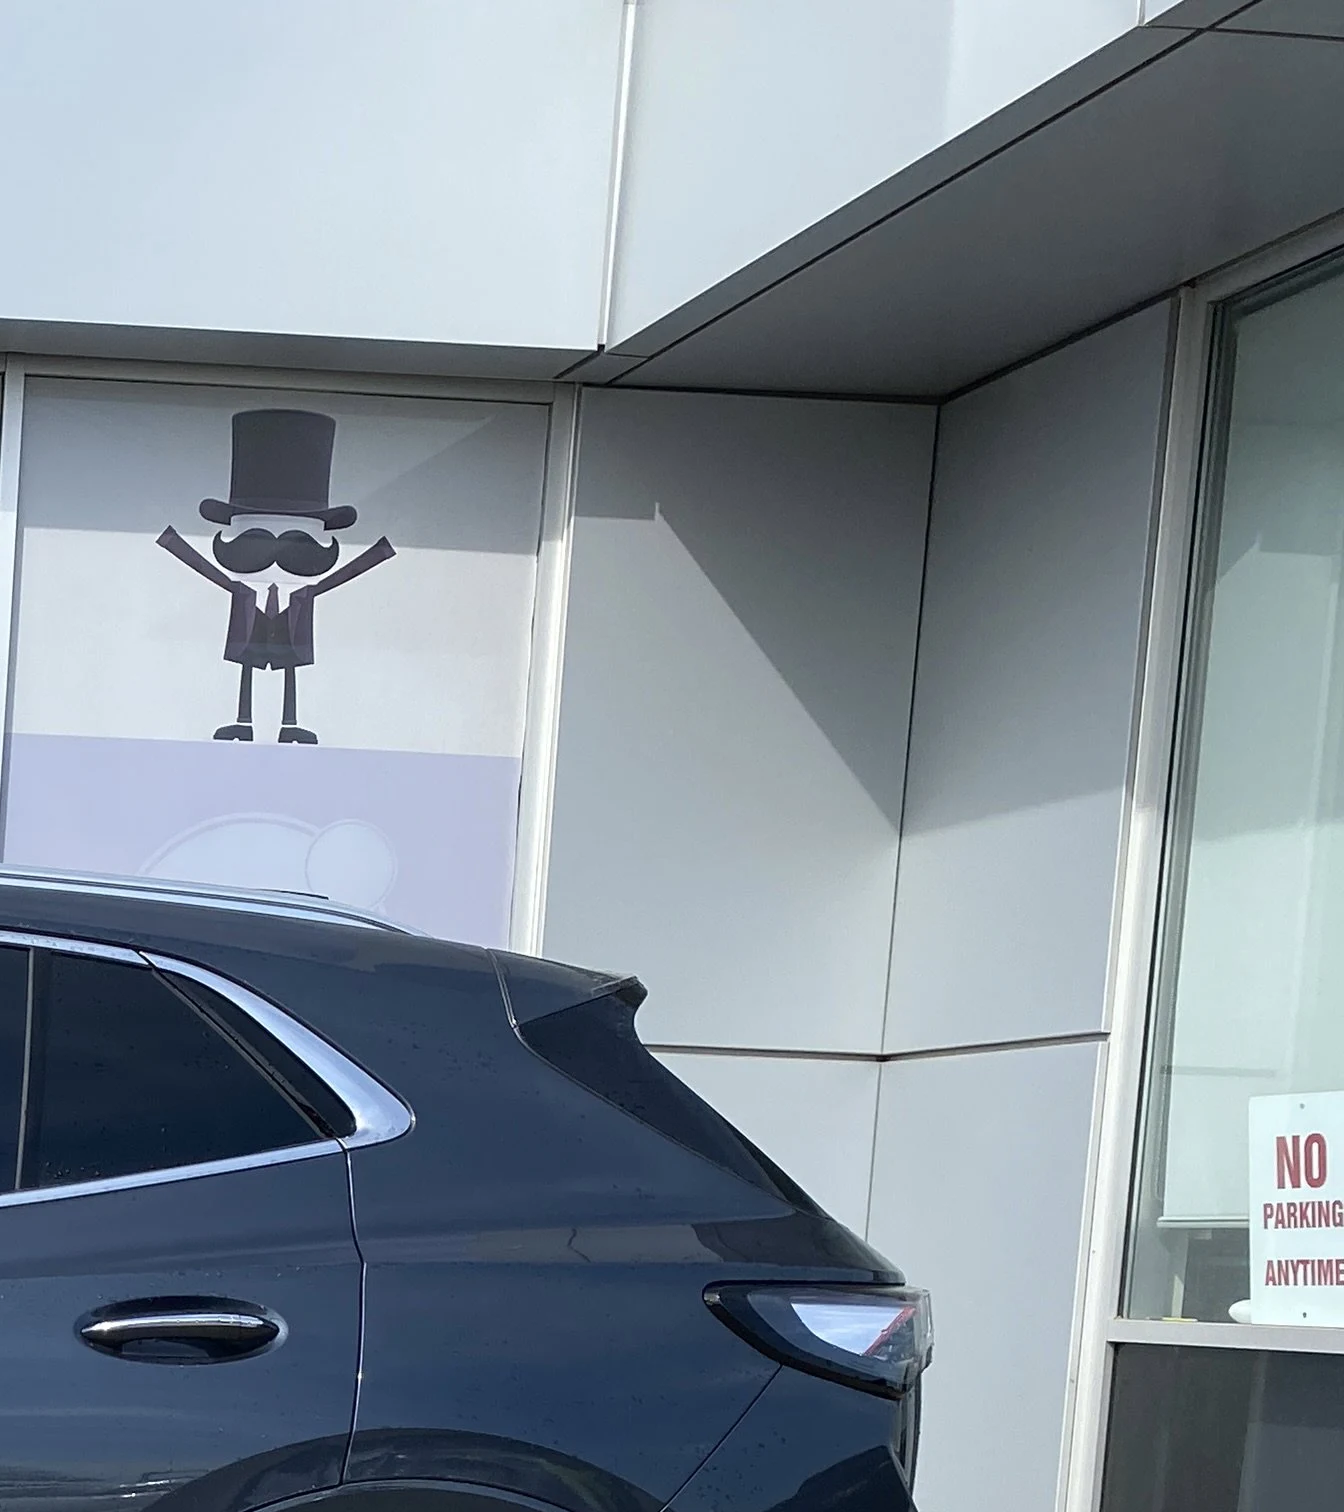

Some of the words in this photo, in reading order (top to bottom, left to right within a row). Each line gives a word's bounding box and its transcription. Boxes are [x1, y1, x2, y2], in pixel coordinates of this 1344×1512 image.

[1276, 1133, 1327, 1189] NO
[1263, 1200, 1344, 1229] PARKING
[1265, 1258, 1344, 1287] ANYTIME
